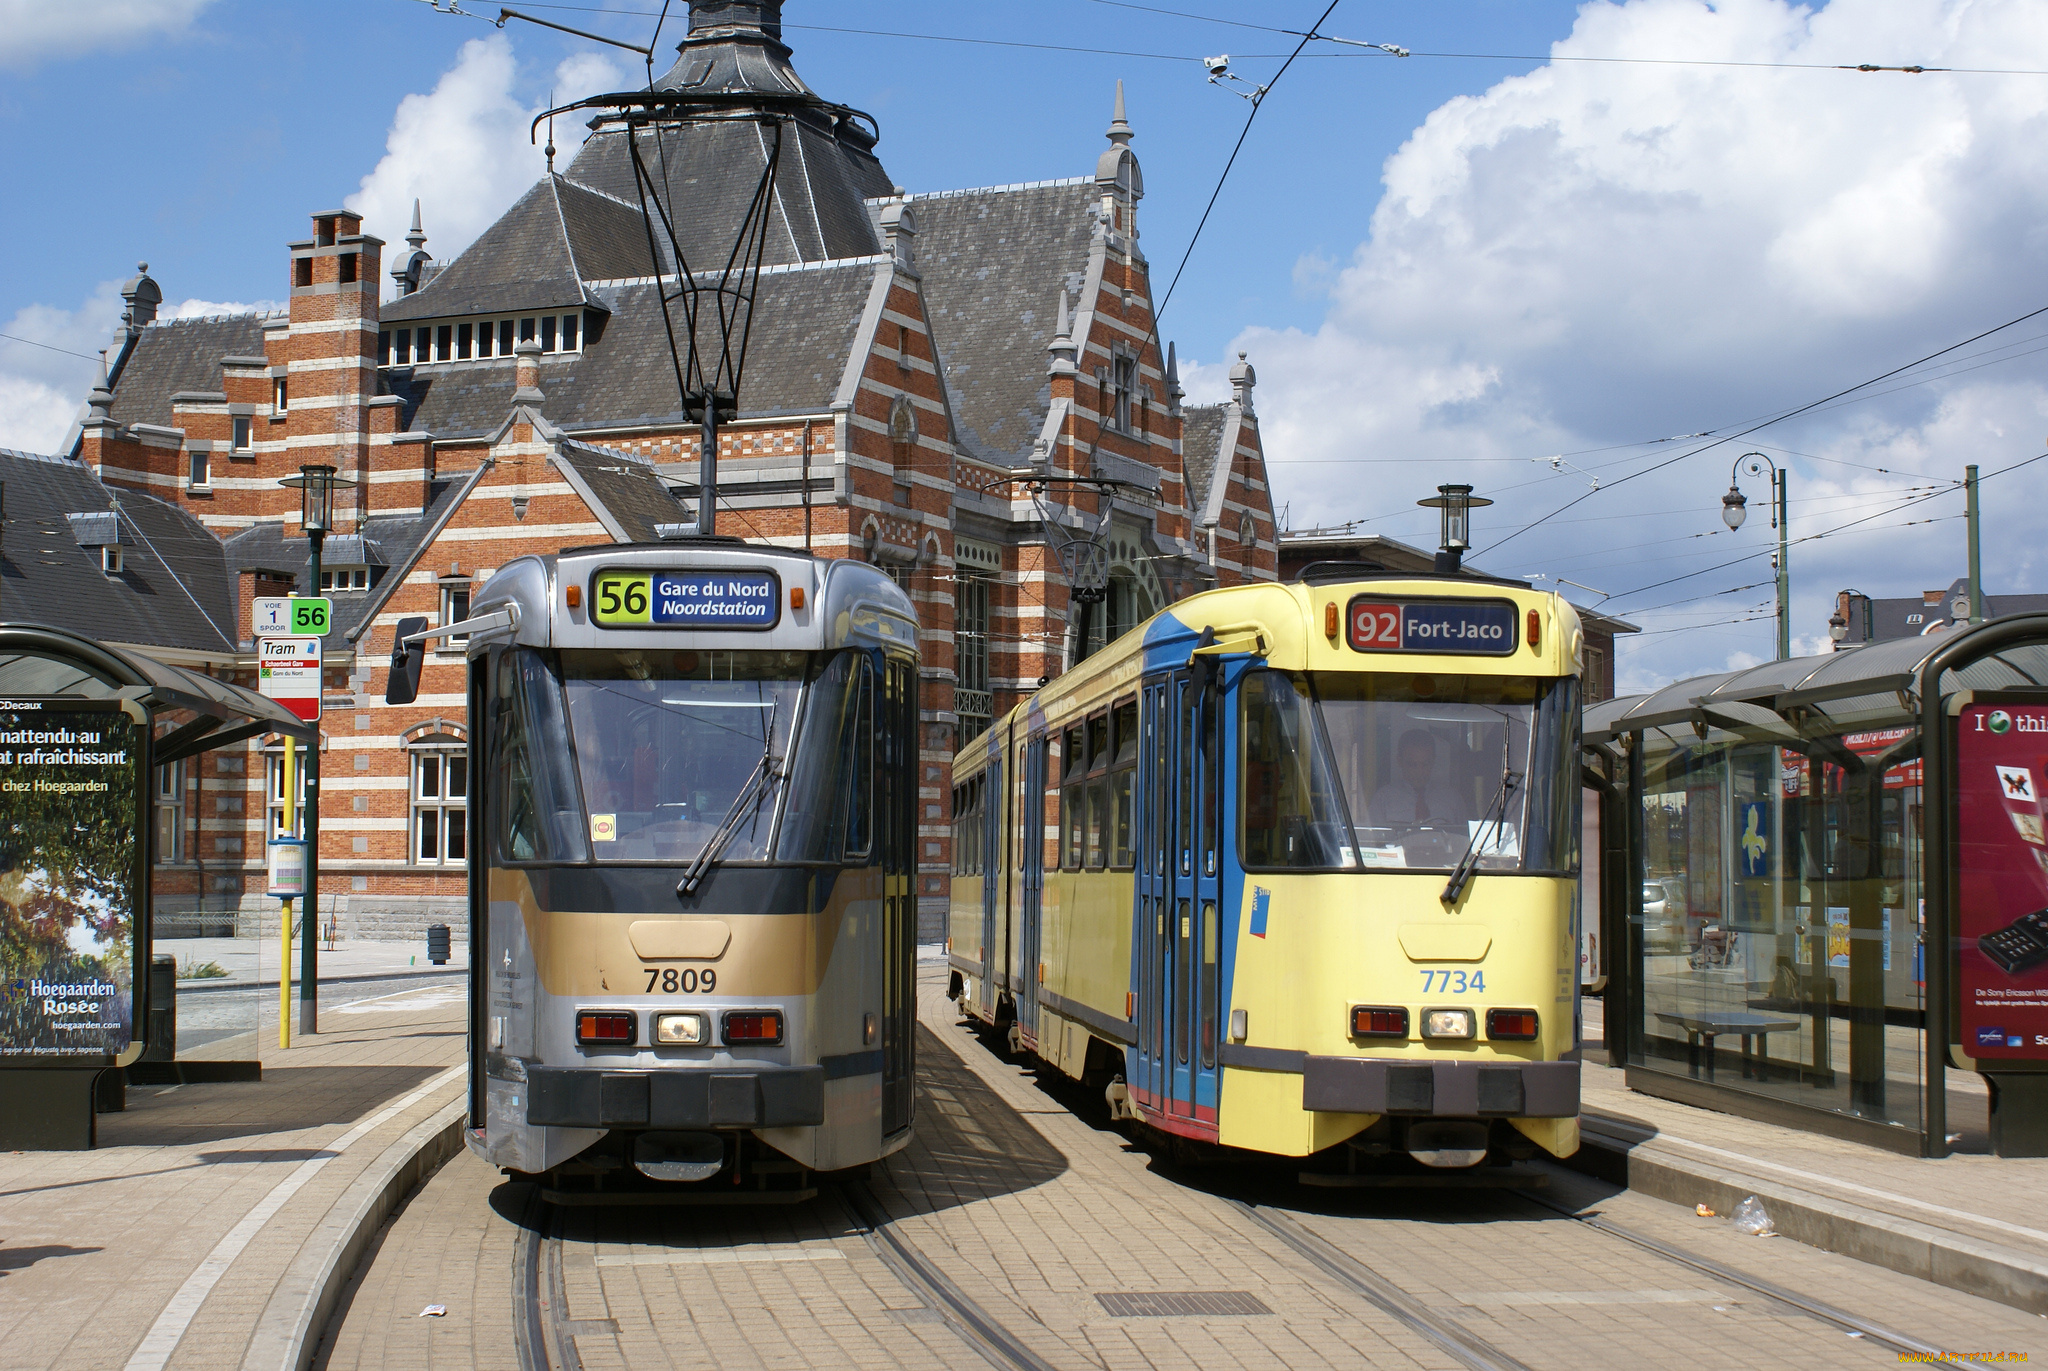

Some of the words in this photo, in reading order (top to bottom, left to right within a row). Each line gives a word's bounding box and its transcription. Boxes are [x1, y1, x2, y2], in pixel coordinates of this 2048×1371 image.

[659, 581, 698, 597] Gare
[702, 581, 724, 597] du
[728, 581, 769, 597] Nord
[600, 581, 648, 615] 56
[662, 600, 766, 616] Noordstation
[270, 611, 276, 623] 1
[297, 608, 325, 626] 56
[1356, 612, 1398, 642] 92
[1407, 619, 1503, 640] Fort-Jaco
[265, 642, 295, 654] Tram
[1975, 714, 1985, 732] I
[2016, 715, 2048, 732] thi
[0, 727, 75, 744] nattendu
[80, 731, 100, 744] au
[17, 748, 126, 765] rafraîchissant
[2, 780, 31, 792] chez
[34, 780, 108, 795] Hoegaarden
[30, 979, 115, 999] Hoegaarden
[644, 968, 717, 993] 7809
[1420, 970, 1486, 993] 7734
[1987, 989, 2004, 997] Sony
[43, 1000, 99, 1016] Rosée
[52, 1021, 120, 1030] hoegaarden.com
